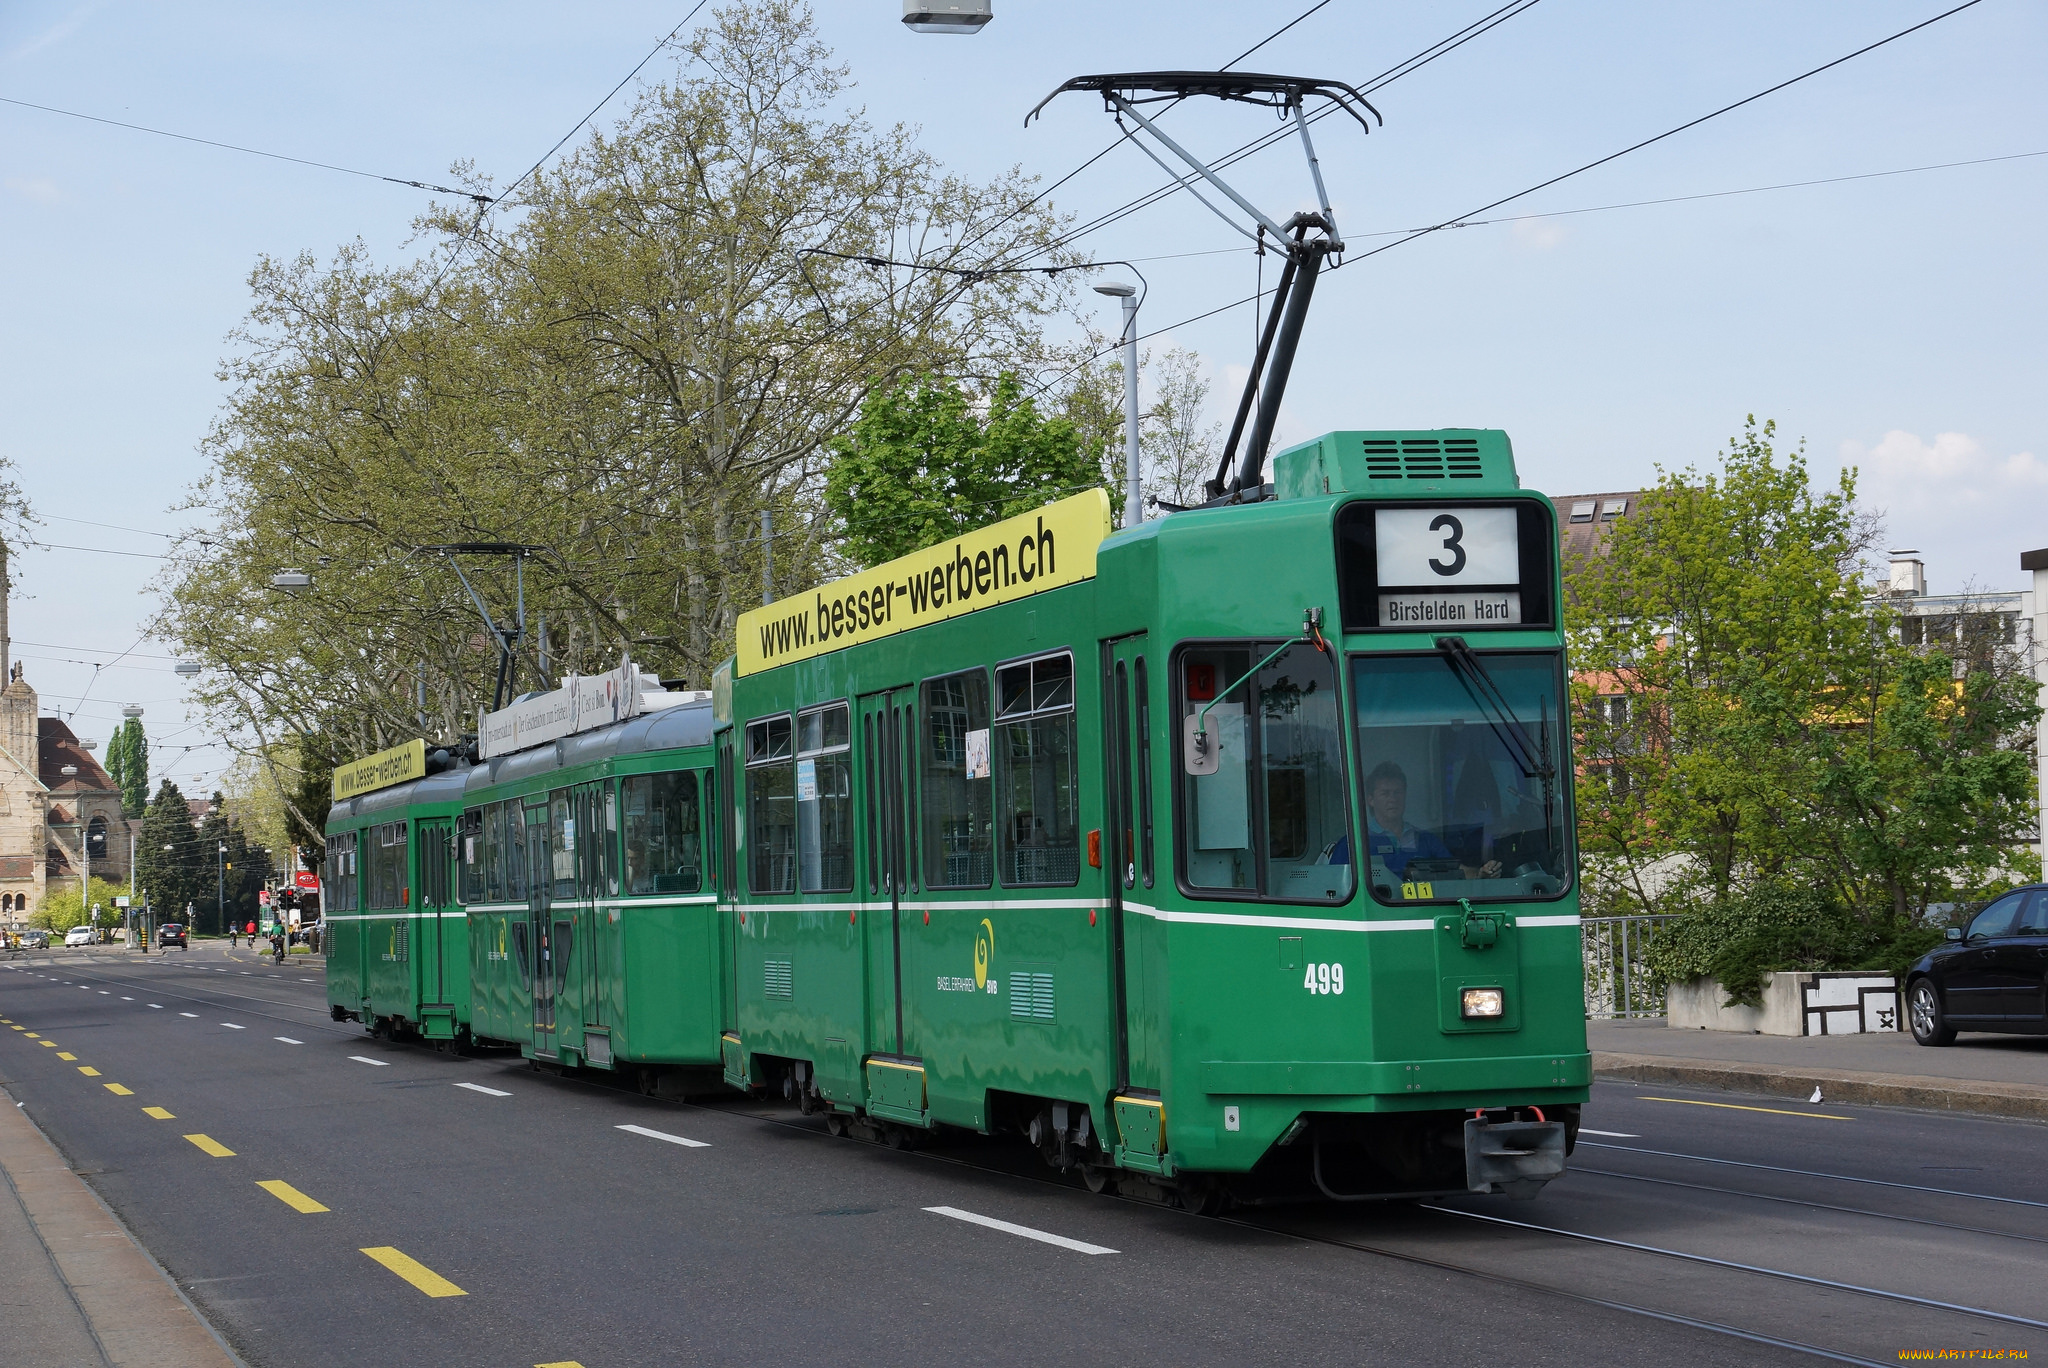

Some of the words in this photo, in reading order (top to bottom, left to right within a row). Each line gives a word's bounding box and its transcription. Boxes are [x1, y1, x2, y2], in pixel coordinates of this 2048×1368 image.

[1428, 513, 1467, 577] 3
[759, 515, 1056, 659] www.besser-werben.ch
[1388, 599, 1466, 621] Birsfelden
[1474, 598, 1509, 620] Hard
[340, 745, 412, 793] www.besser-werben.ch
[1407, 886, 1413, 897] 4
[1423, 886, 1428, 896] 1
[936, 976, 952, 991] BASEL
[1303, 962, 1344, 995] 499
